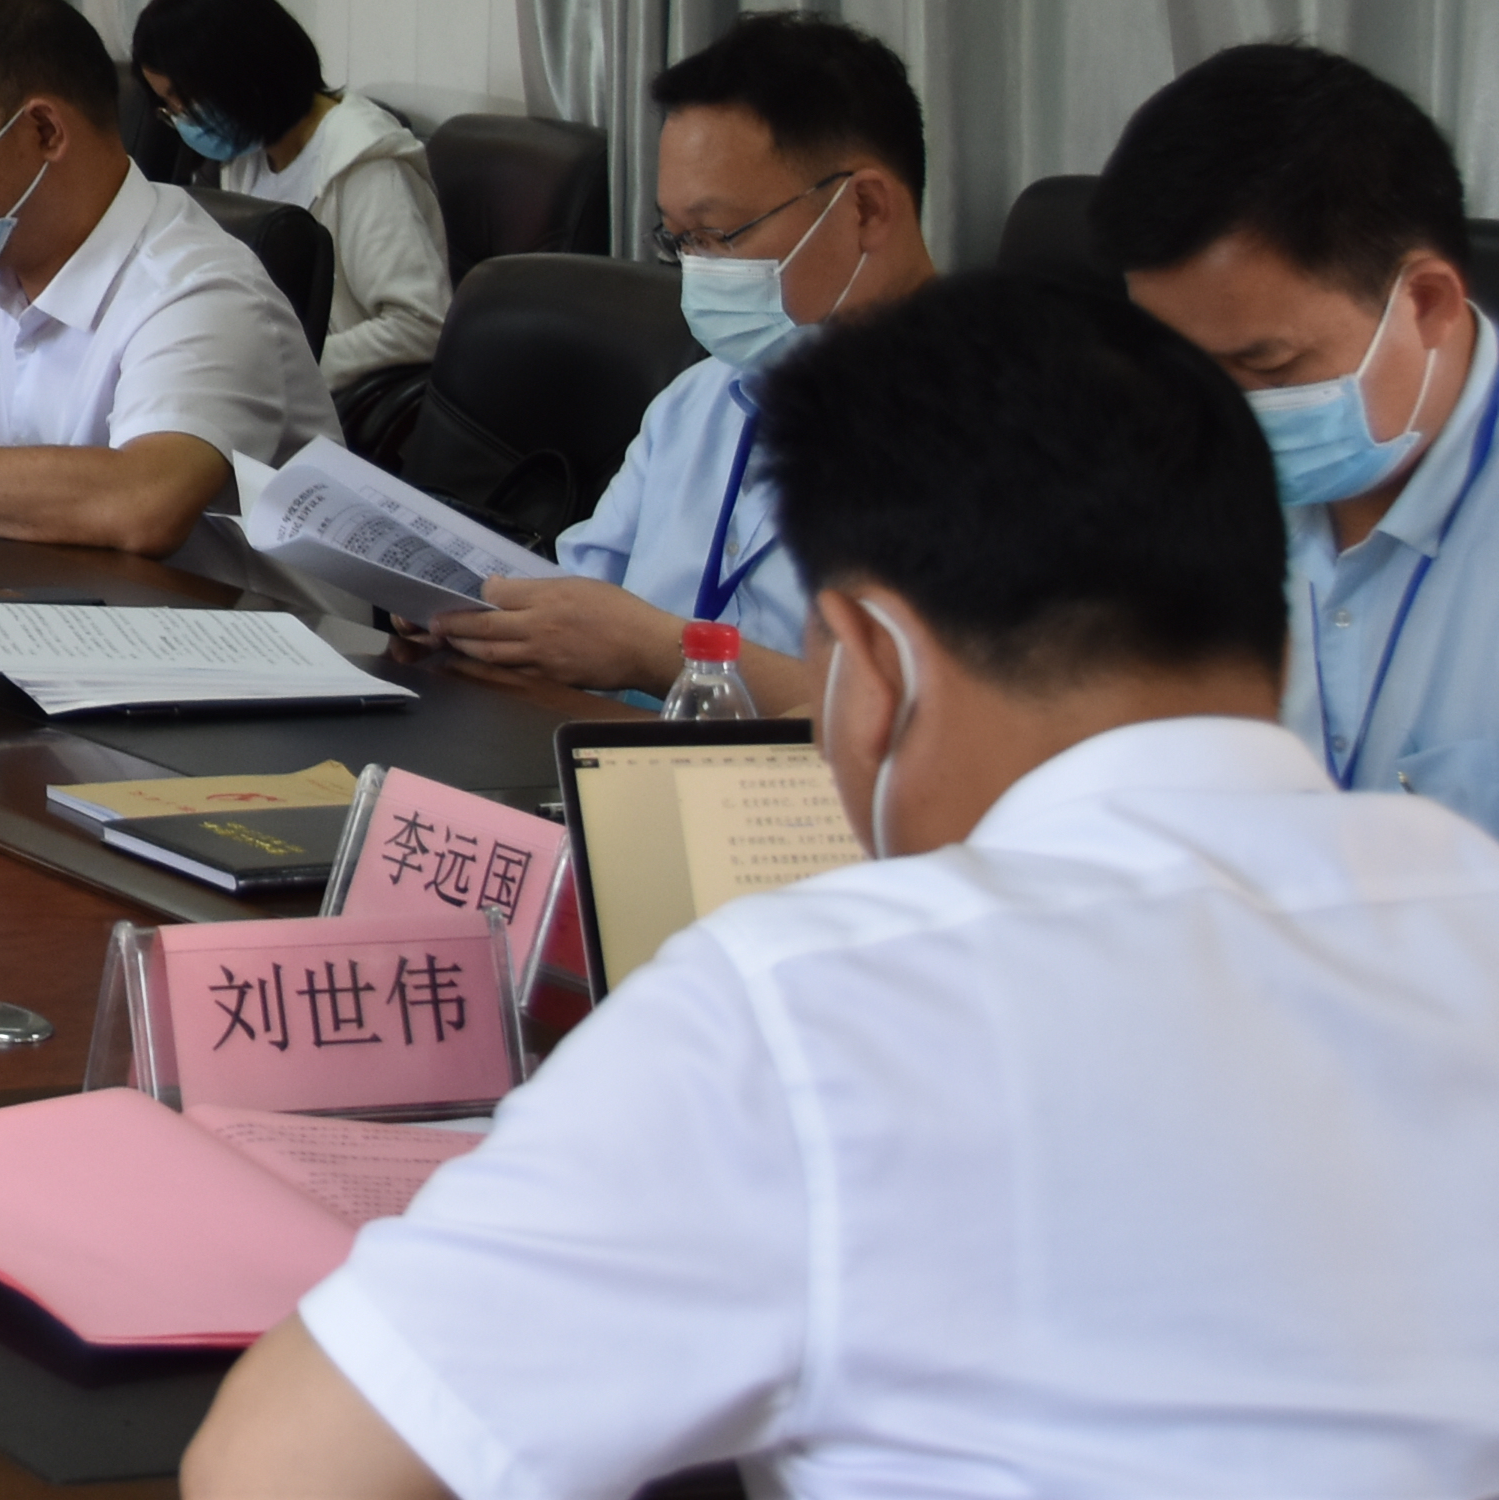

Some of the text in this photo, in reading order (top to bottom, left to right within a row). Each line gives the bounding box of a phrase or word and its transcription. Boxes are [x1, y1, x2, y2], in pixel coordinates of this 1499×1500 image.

[381, 810, 533, 926] 李远国
[208, 952, 467, 1055] 刘世伟
